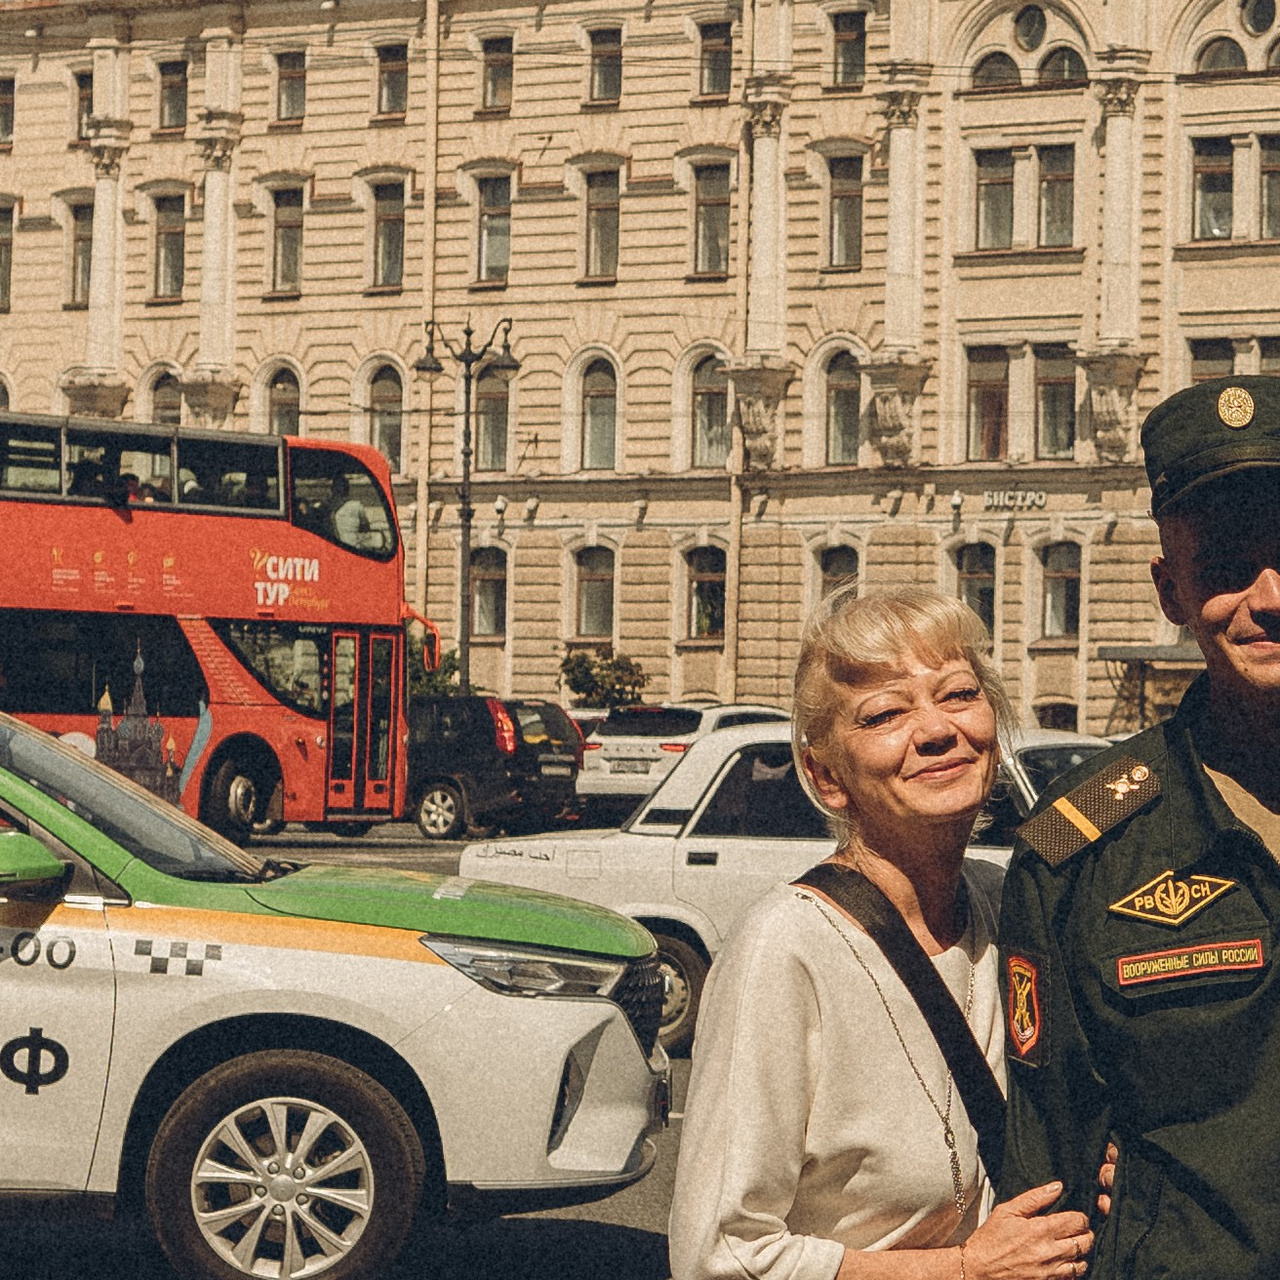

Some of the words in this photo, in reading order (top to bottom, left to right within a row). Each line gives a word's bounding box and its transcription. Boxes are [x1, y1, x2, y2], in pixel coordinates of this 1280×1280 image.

[983, 491, 1047, 507] БИСТРО
[266, 556, 319, 582] СИТИ
[254, 581, 290, 606] ТУР
[1134, 895, 1155, 911] РВ
[1191, 881, 1211, 899] СН
[0, 931, 76, 970] 00
[1122, 955, 1190, 979] ВООРУЖЕННЫЕ
[1192, 951, 1219, 967] СИЛЫ
[1222, 947, 1258, 963] РОССИИ
